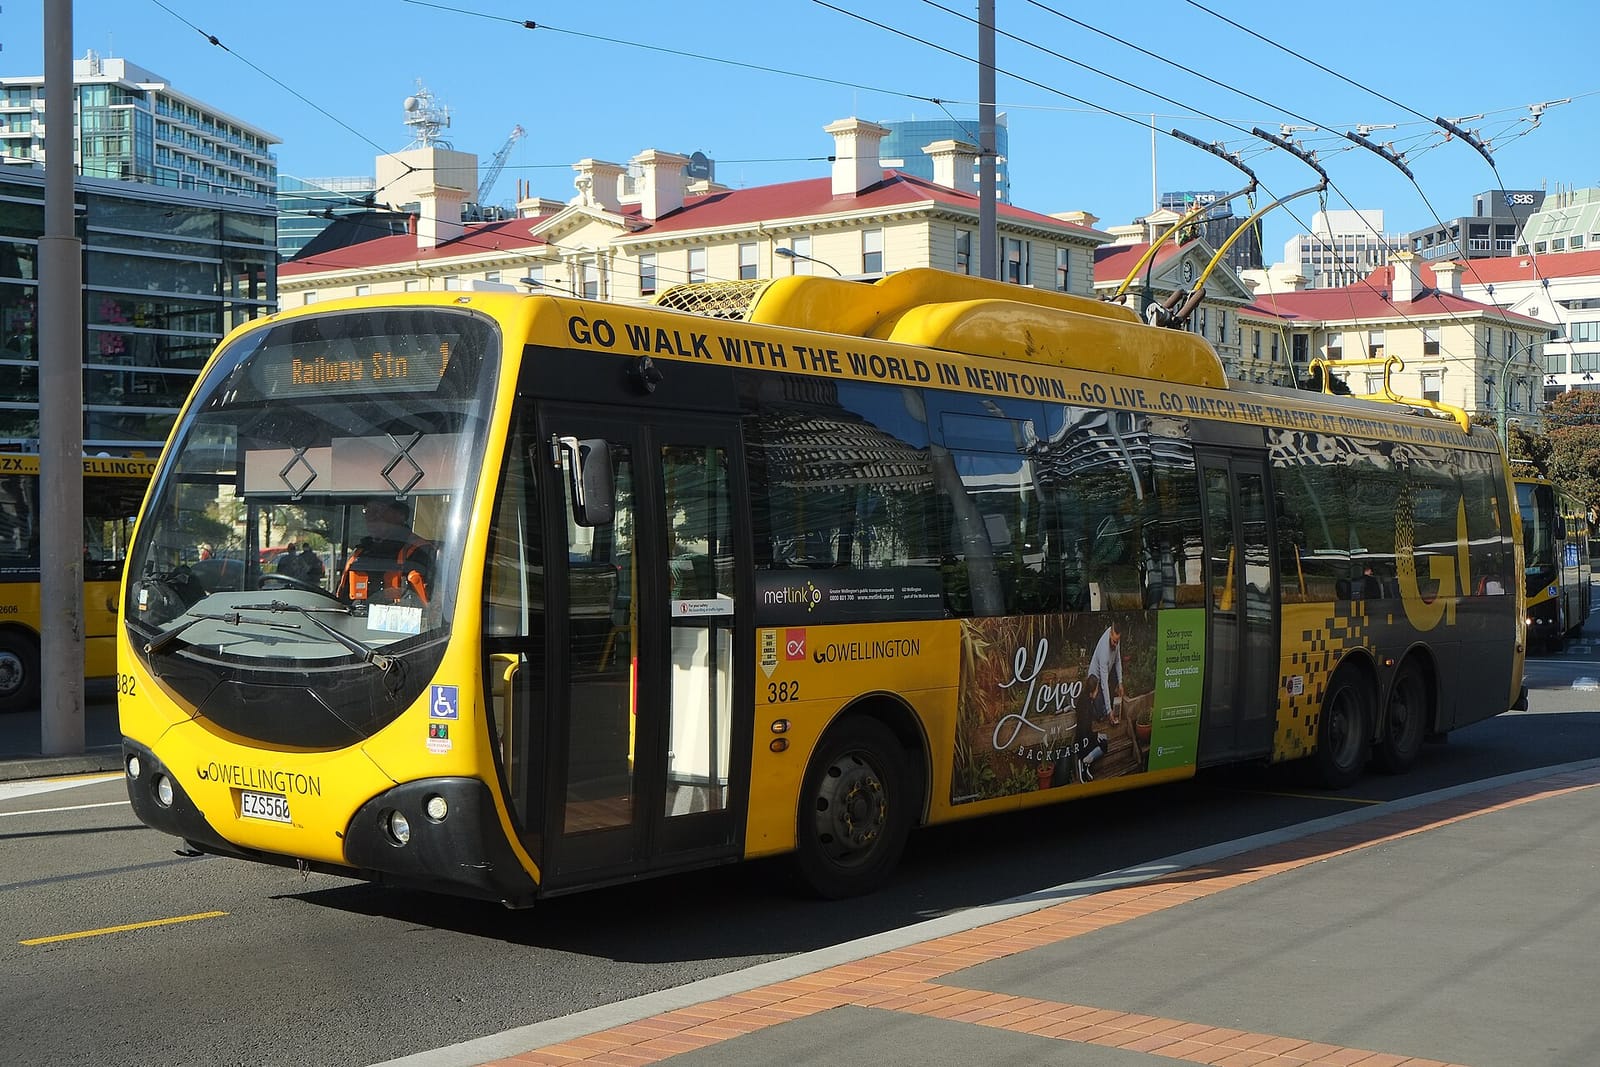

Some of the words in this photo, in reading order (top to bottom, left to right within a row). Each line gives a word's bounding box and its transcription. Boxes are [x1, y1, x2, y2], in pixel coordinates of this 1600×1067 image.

[1513, 194, 1534, 204] sas
[292, 357, 363, 384] Railway
[372, 352, 407, 379] Stn
[568, 317, 615, 347] GO
[624, 324, 712, 359] WALK
[718, 337, 787, 368] WITH
[793, 346, 842, 373] THE
[847, 352, 931, 382] WORLD
[936, 362, 960, 385] IN
[1185, 395, 1237, 419] WATCH
[1238, 403, 1266, 422] THE
[1266, 406, 1320, 429] TRAFFIC
[1322, 415, 1336, 431] AT
[1339, 415, 1392, 438] ORIENTAL
[1437, 430, 1496, 449] WELLINGTON
[764, 586, 808, 604] metlink
[1166, 640, 1190, 652] backyard
[1165, 665, 1199, 676] Conservation
[767, 680, 799, 704] 382
[1164, 678, 1181, 689] Week!
[1017, 737, 1090, 761] BACKYARD
[243, 794, 290, 818] EZS560
